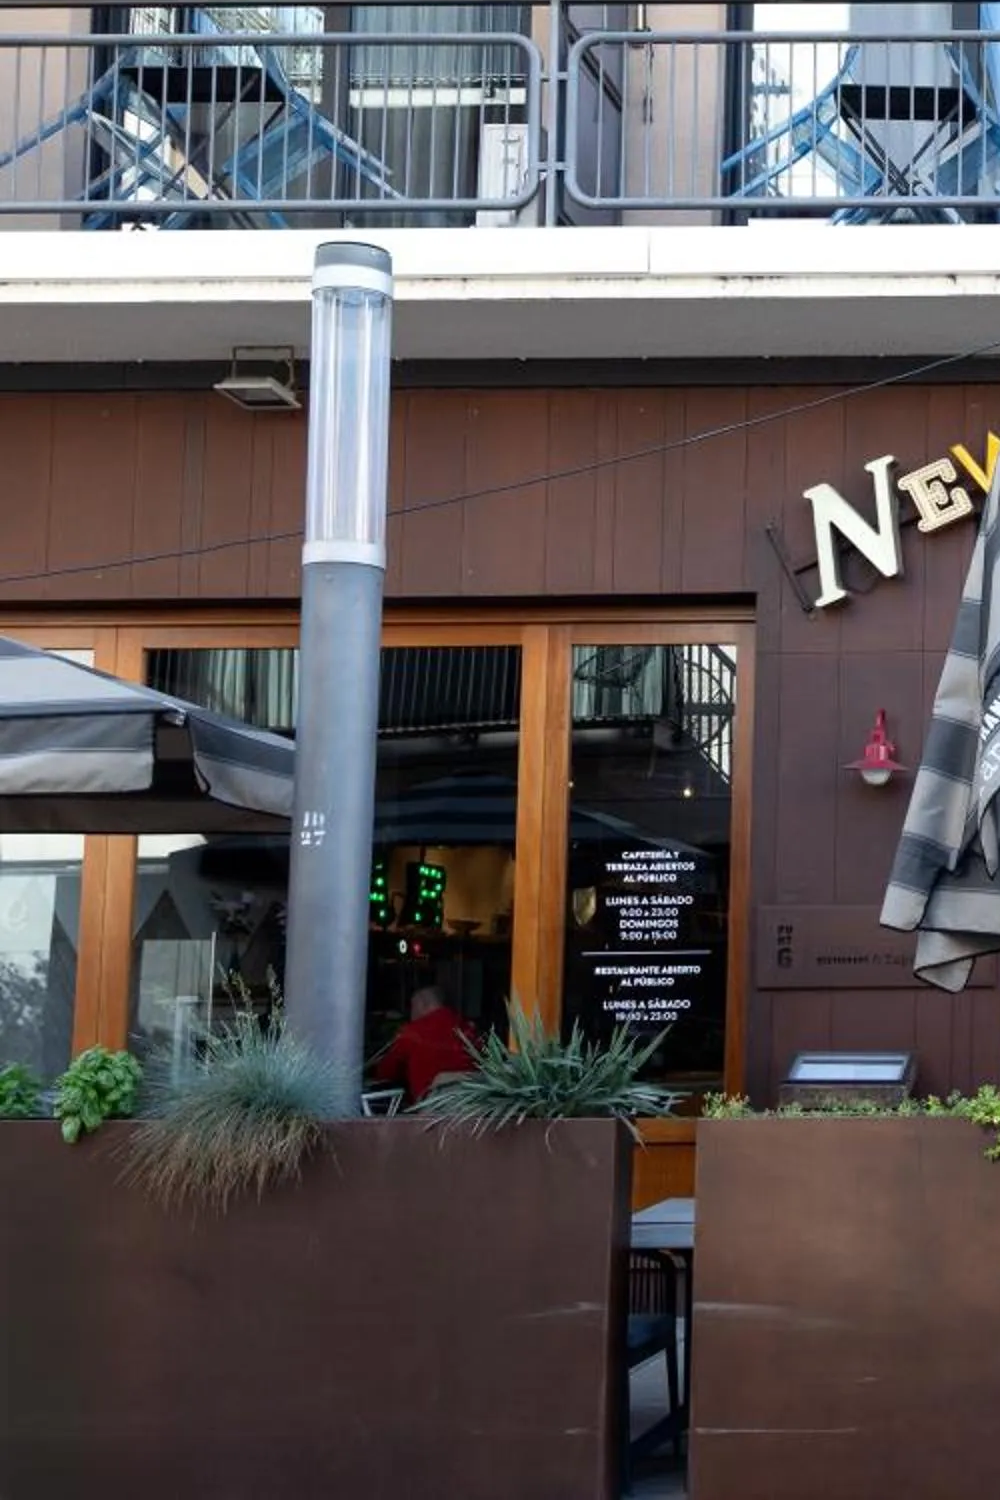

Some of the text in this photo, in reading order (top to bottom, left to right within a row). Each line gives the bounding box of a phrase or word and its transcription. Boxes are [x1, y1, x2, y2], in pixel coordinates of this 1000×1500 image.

[621, 849, 680, 860] CAFETERÍA Y
[605, 861, 696, 871] TERRAZA ABIERTOS
[623, 872, 677, 883] AL PÚBLICO
[605, 894, 694, 906] LUNES A SÁBADO
[619, 919, 679, 929] DOMINGOS
[594, 965, 701, 975] RESTAURANTE ABIERTO
[620, 975, 675, 987] AL PÚBLICO
[603, 997, 691, 1010] LUNES A SÁBADO
